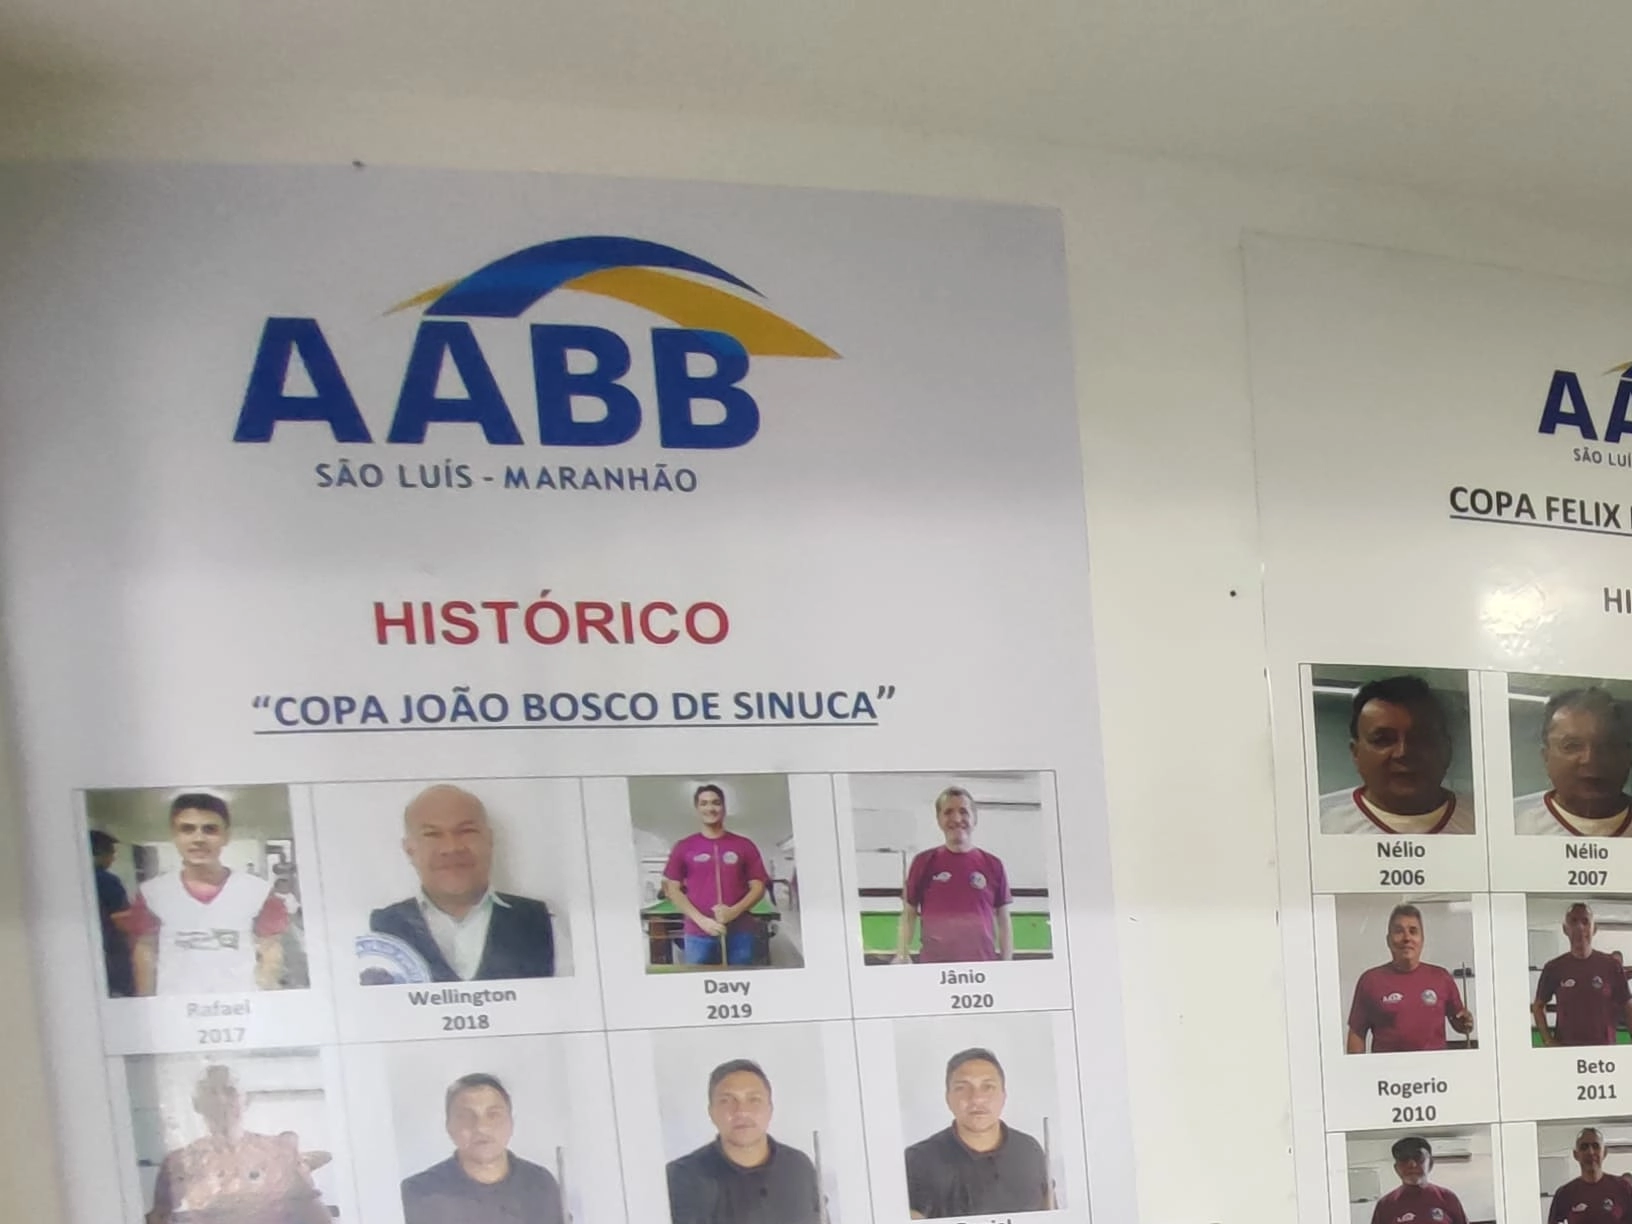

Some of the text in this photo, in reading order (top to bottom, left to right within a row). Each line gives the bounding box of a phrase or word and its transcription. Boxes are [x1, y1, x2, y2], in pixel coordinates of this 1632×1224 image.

[231, 317, 760, 450] AABB
[1573, 447, 1602, 465] SÃO
[315, 458, 384, 490] SÃO
[400, 457, 474, 491] LUÍS
[504, 461, 699, 494] MARANHÃO
[1449, 486, 1536, 520] COPA
[1546, 496, 1621, 530] FELIX
[374, 588, 730, 647] HISTÓRICO
[400, 686, 510, 727] JOÃO
[523, 690, 660, 723] BOSCO
[672, 691, 721, 722] DE
[1377, 841, 1425, 858] Nélio
[1565, 843, 1608, 860] Nélio
[1379, 869, 1425, 886] 2006
[1568, 870, 1608, 886] 2007
[939, 968, 986, 986] Jânio
[704, 978, 752, 997] Davy
[408, 987, 517, 1008] Wellington
[950, 993, 994, 1009] 2020
[186, 999, 252, 1018] Rafael
[707, 1003, 753, 1020] 2019
[441, 1014, 490, 1031] 2018
[198, 1027, 246, 1045] 2017
[1576, 1059, 1615, 1074] Beto
[1377, 1077, 1448, 1099] Rogerio
[1577, 1084, 1617, 1101] 2011
[1391, 1105, 1437, 1123] 2010
